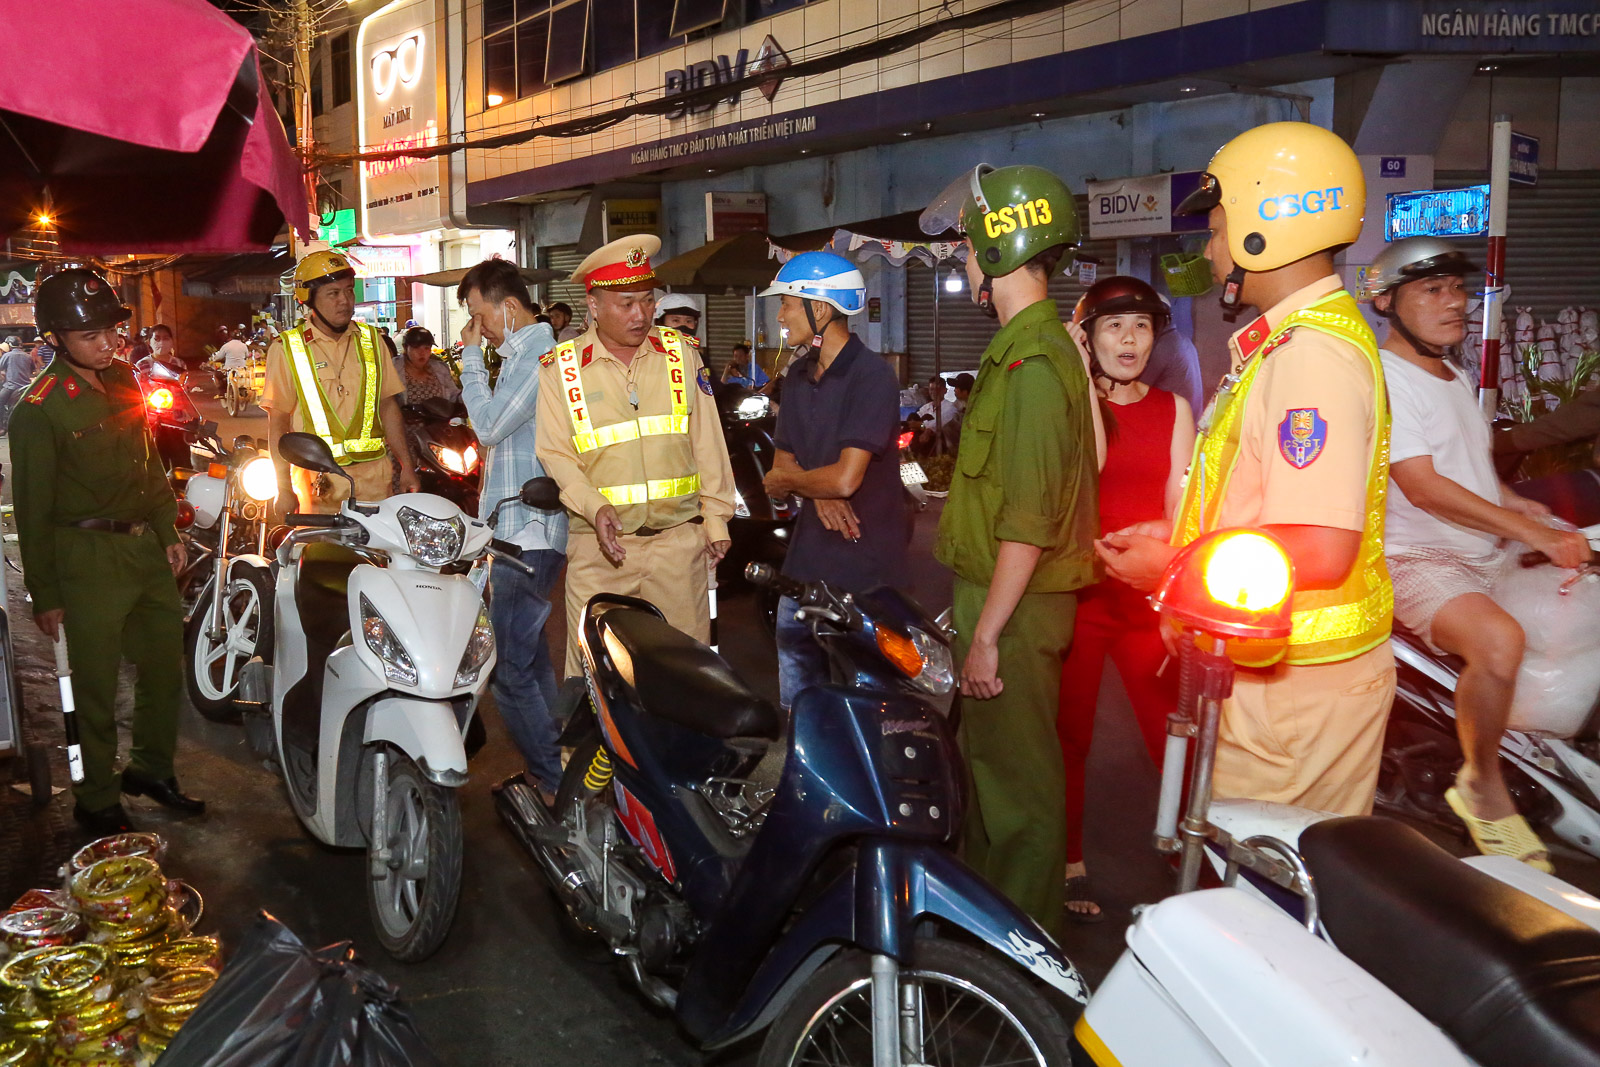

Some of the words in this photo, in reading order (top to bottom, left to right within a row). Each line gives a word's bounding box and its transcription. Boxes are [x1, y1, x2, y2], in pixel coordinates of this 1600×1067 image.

[1421, 8, 1480, 36] NGÂN
[1483, 9, 1541, 37] HÀNG
[631, 147, 650, 165] NGÂN
[650, 144, 669, 161] HÀNG
[669, 144, 690, 156] TMCP
[716, 131, 727, 149] VÀ
[728, 126, 749, 146] PHÁT
[750, 119, 774, 143] TRIỂN
[775, 117, 794, 139] VIỆT
[795, 116, 816, 132] NAM
[1387, 160, 1400, 171] 60
[984, 198, 1053, 239] CS113
[1100, 193, 1141, 216] BIDV
[1258, 187, 1344, 221] CSGT
[560, 348, 584, 421] CSGT
[663, 331, 684, 404] CSGT
